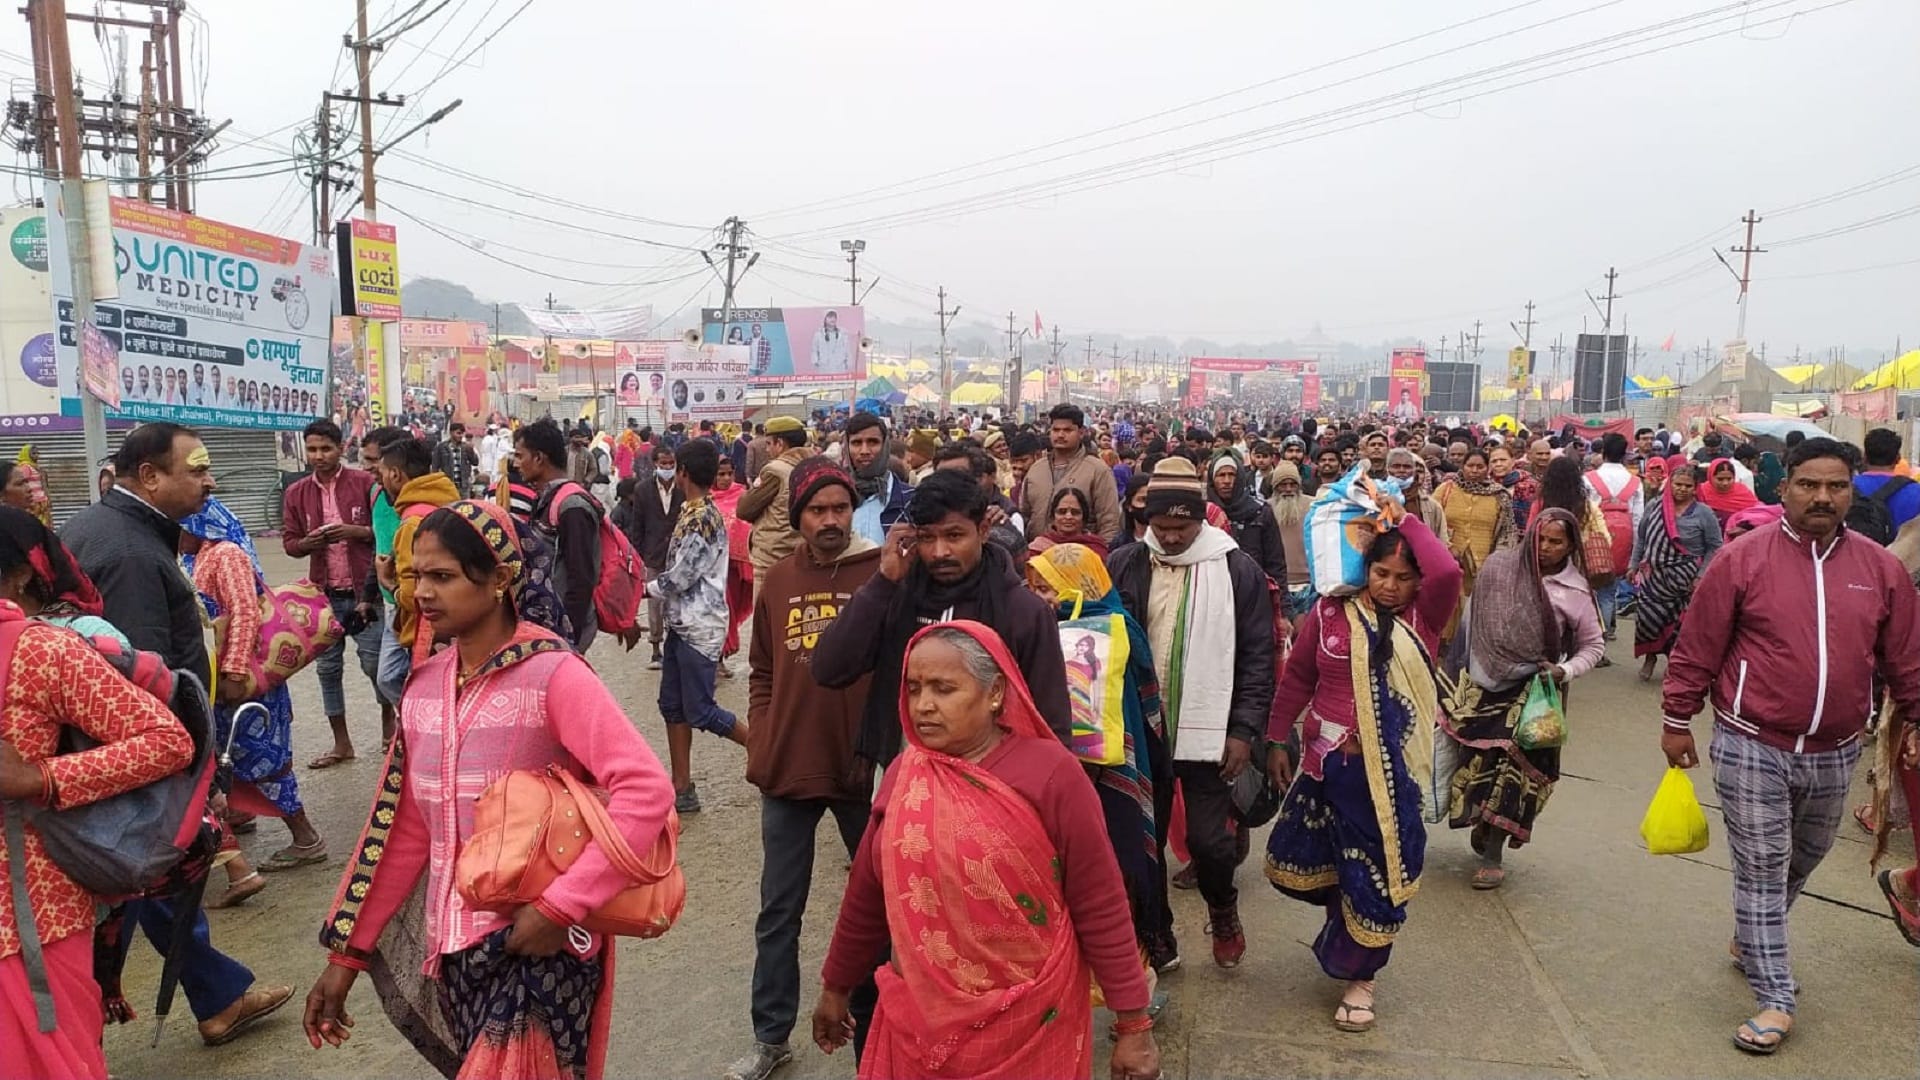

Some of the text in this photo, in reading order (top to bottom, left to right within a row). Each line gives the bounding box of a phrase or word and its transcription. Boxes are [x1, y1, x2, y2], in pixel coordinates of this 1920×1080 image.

[132, 237, 259, 292] UNITED
[359, 248, 391, 263] LUX
[359, 265, 395, 287] cozi
[136, 272, 259, 311] MEDICITY
[155, 296, 244, 321] Super Speciality Hospital
[730, 309, 769, 320] RENDS
[261, 338, 301, 372] सम्पूर्ण
[721, 359, 749, 372] परिवार
[289, 365, 324, 385] इलाज
[368, 349, 380, 395] LUX
[133, 404, 158, 419] (Near
[804, 592, 833, 602] FASHION
